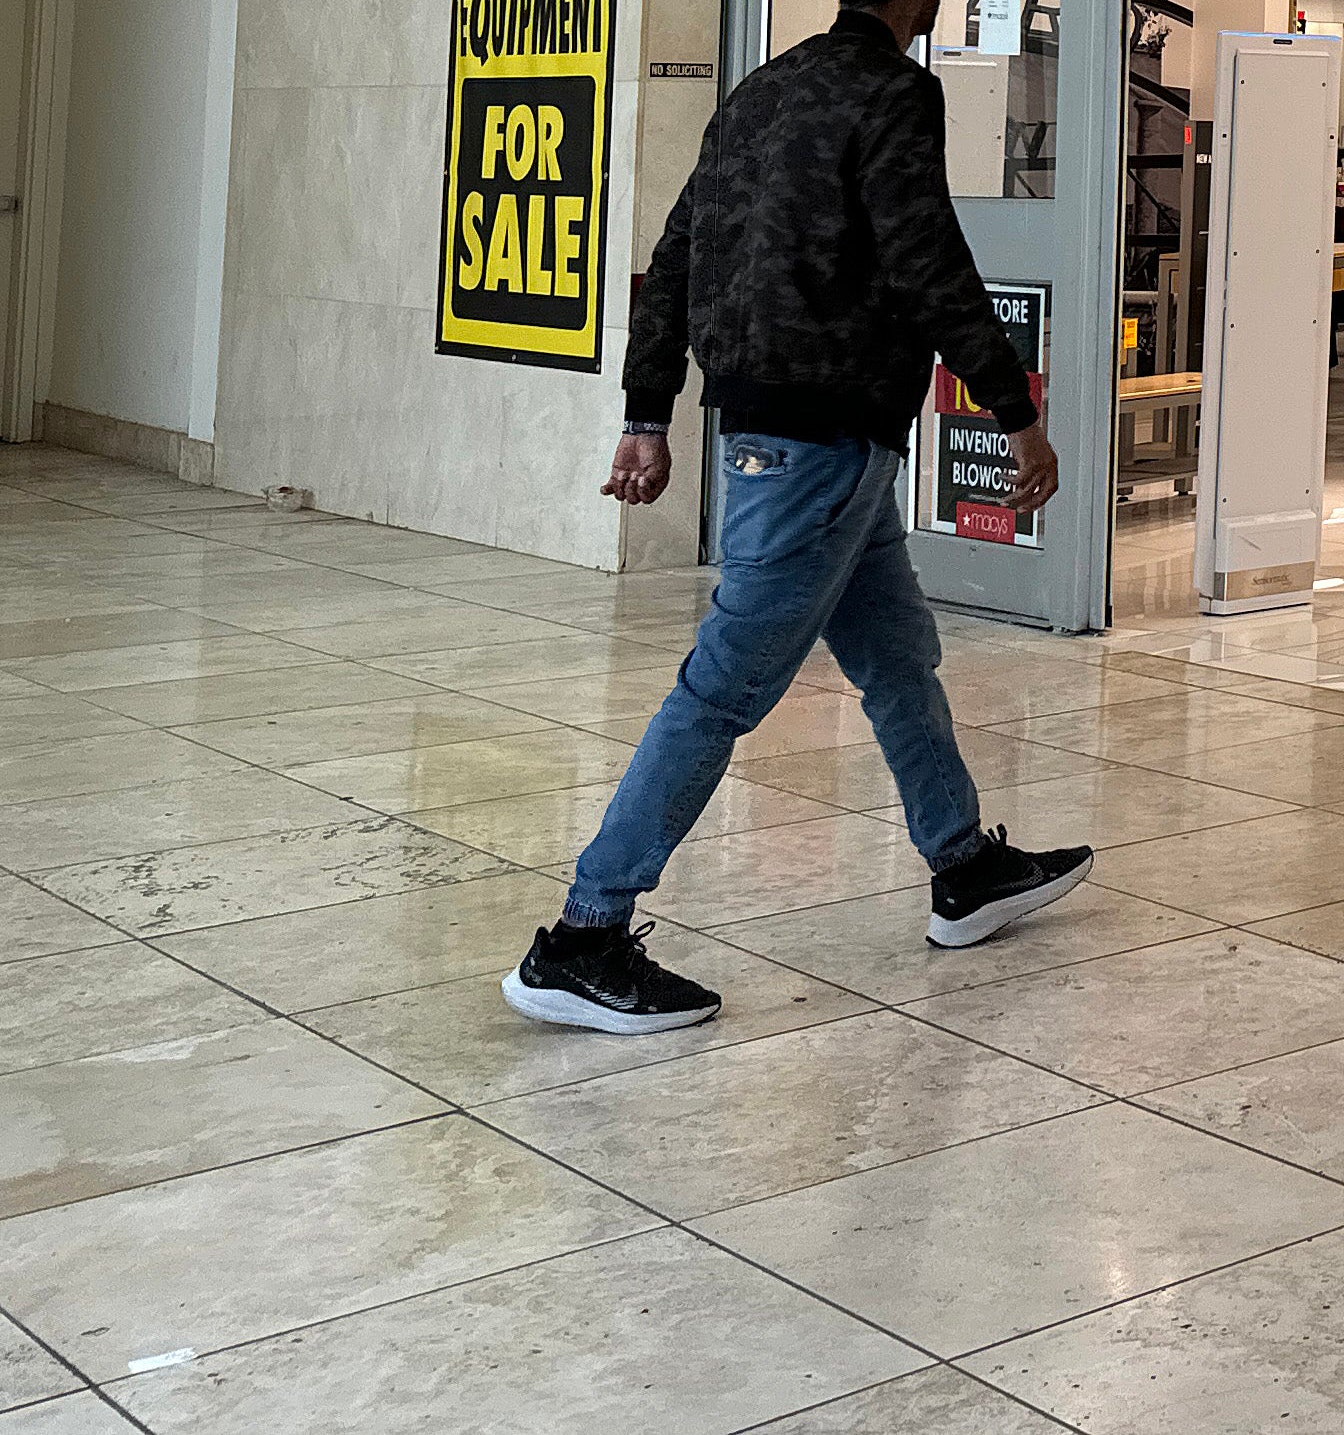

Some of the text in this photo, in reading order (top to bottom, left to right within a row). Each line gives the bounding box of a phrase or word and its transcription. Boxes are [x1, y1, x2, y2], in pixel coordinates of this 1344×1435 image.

[651, 64, 712, 76] NO SOLICITING
[481, 104, 564, 181] FOR
[459, 191, 585, 298] SALE
[992, 298, 1029, 324] TORE
[950, 427, 1014, 458] INVENTO
